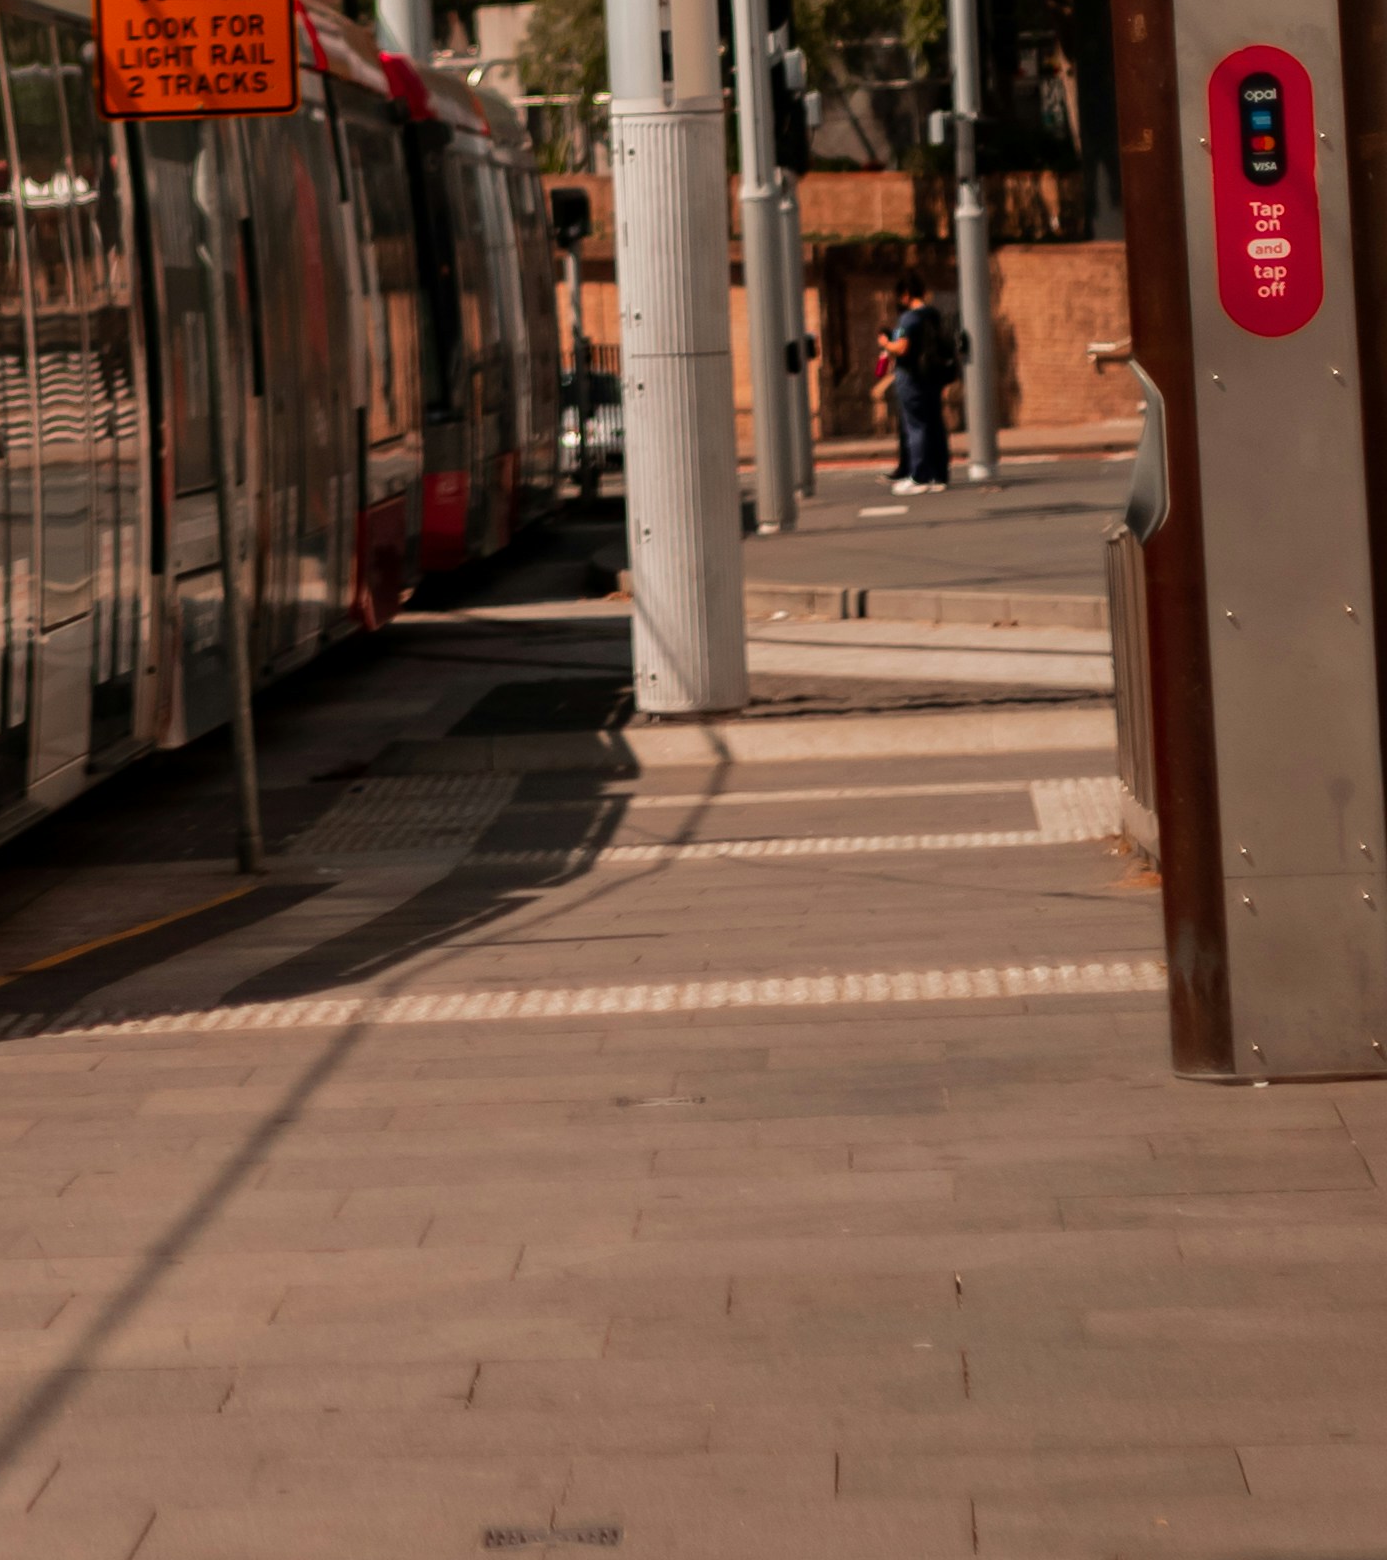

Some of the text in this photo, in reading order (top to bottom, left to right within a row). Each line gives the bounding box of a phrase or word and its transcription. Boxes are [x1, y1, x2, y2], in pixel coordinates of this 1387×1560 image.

[126, 14, 264, 41] LOOK FOR
[119, 43, 275, 69] LIGHT RAIL
[128, 71, 268, 98] 2 TRACKS
[1244, 88, 1277, 103] opal
[1253, 161, 1277, 171] VISA
[1249, 201, 1285, 218] Tap
[1255, 219, 1281, 232] on
[1255, 243, 1283, 255] and
[1254, 265, 1287, 281] tap
[1258, 281, 1286, 298] off
